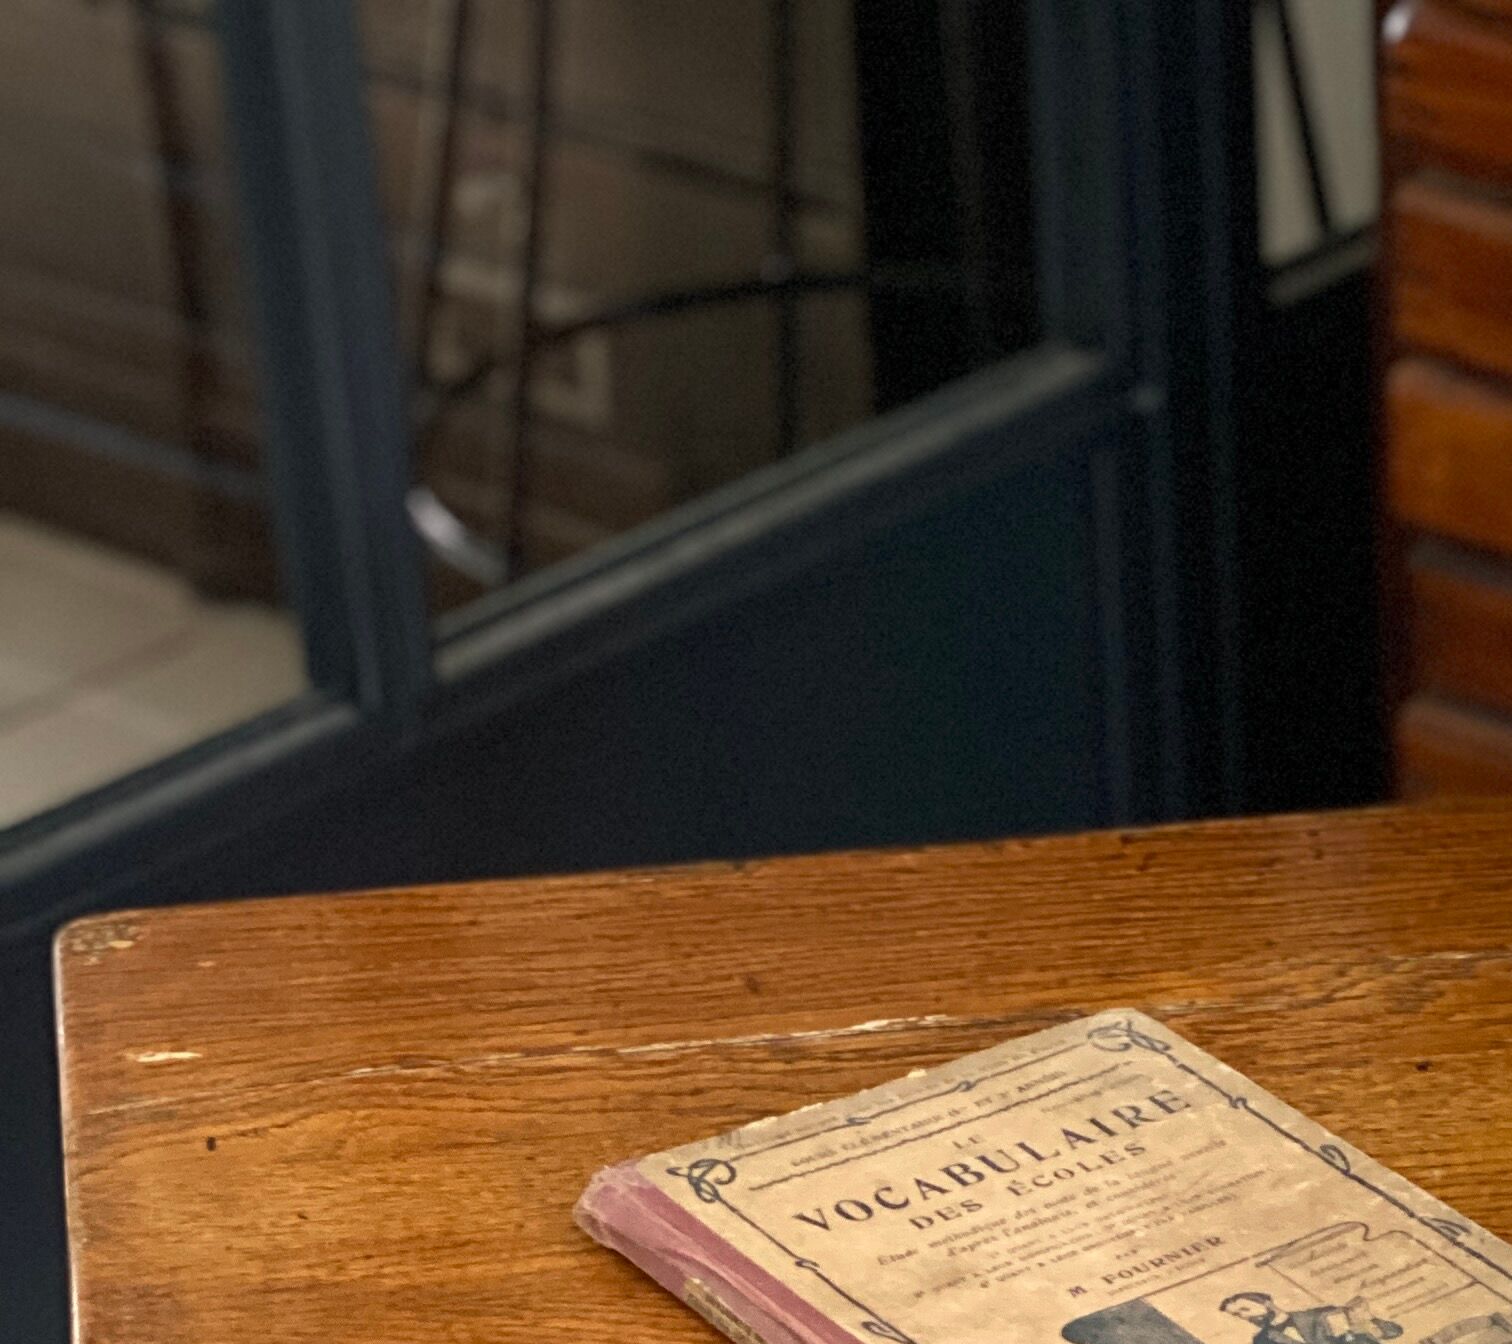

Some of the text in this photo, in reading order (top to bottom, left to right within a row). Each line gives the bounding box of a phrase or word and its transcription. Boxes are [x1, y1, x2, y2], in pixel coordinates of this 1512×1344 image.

[793, 1089, 1191, 1234] VOCABULAIRE
[907, 1142, 1148, 1229] DES ÉCOLES
[1101, 1234, 1226, 1284] FOURNIER
